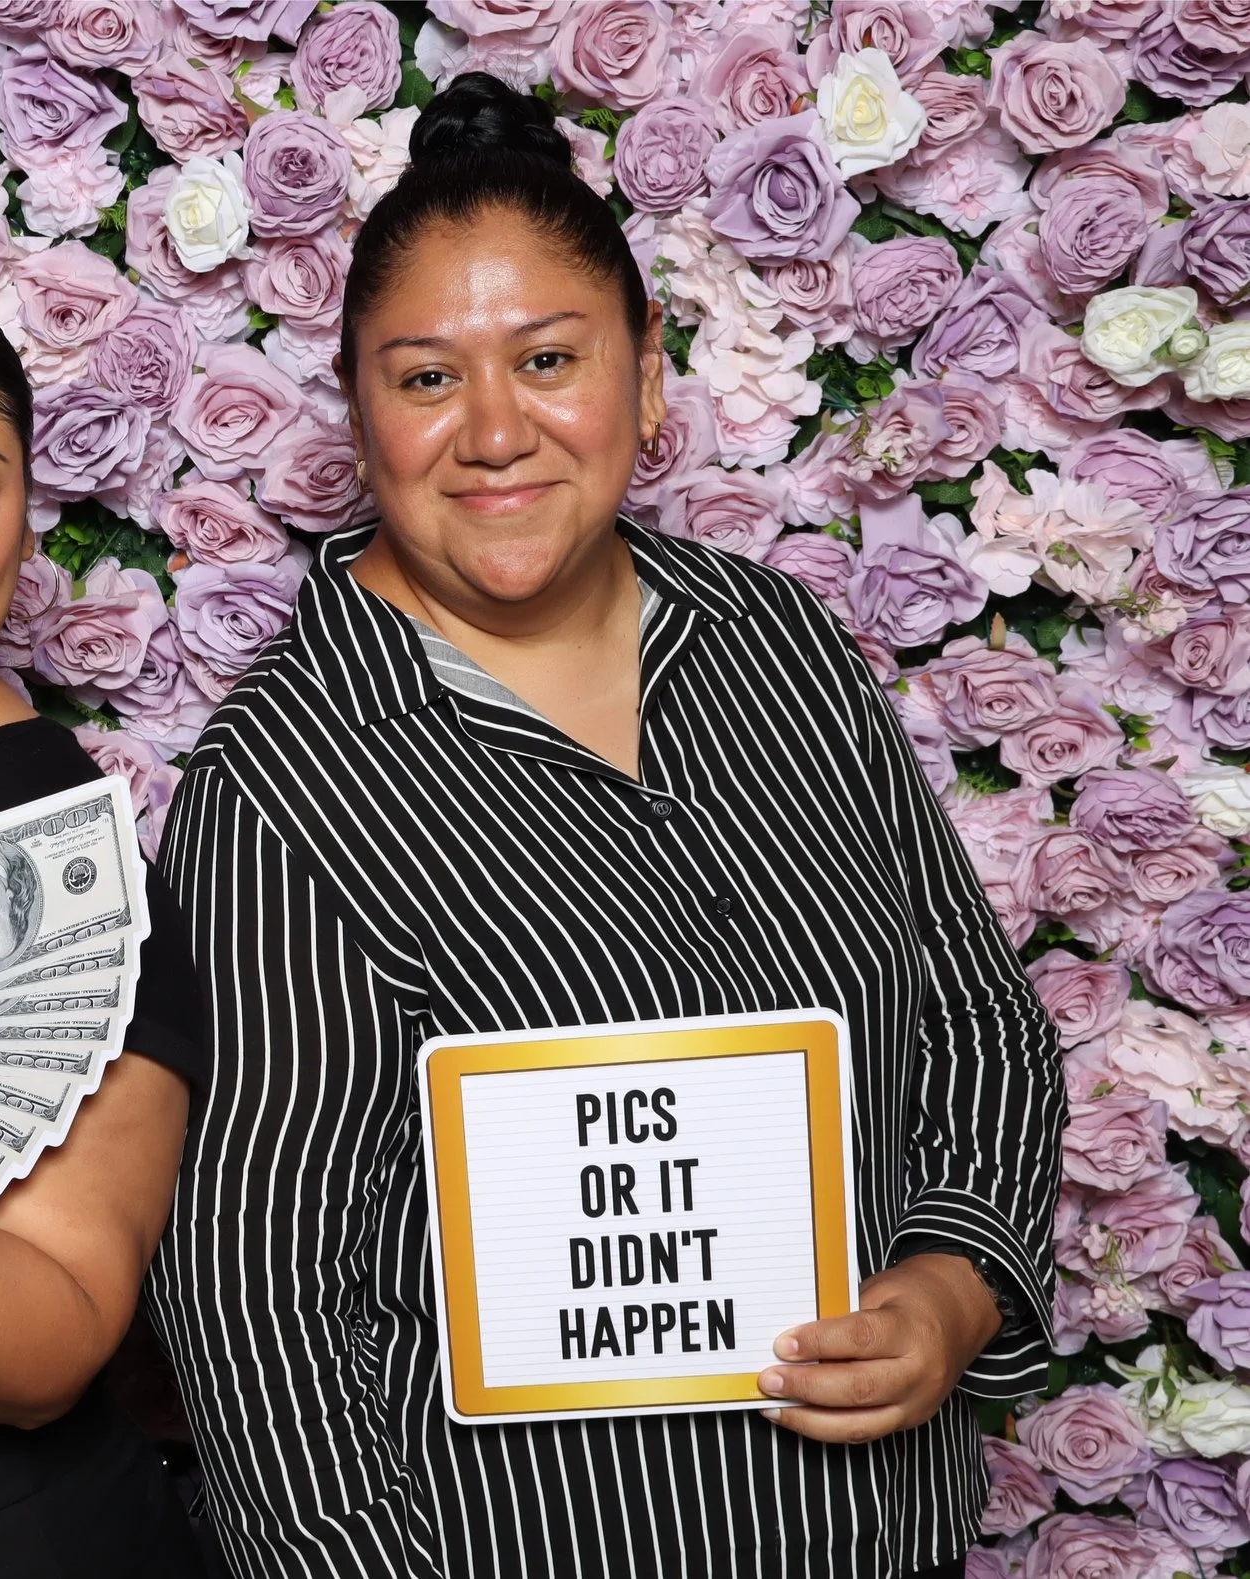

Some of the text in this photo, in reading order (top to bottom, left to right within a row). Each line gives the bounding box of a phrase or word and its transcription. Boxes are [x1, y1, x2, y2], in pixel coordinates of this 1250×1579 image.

[40, 804, 101, 836] 100
[45, 916, 119, 952] 100
[39, 954, 113, 980] 100
[34, 996, 108, 1012] 100
[24, 1028, 97, 1039] 100
[6, 1054, 79, 1071] 100
[576, 1087, 677, 1147] PICS
[580, 1158, 699, 1218] OR IT
[569, 1228, 718, 1290] DIDN'T
[559, 1298, 736, 1360] HAPPEN
